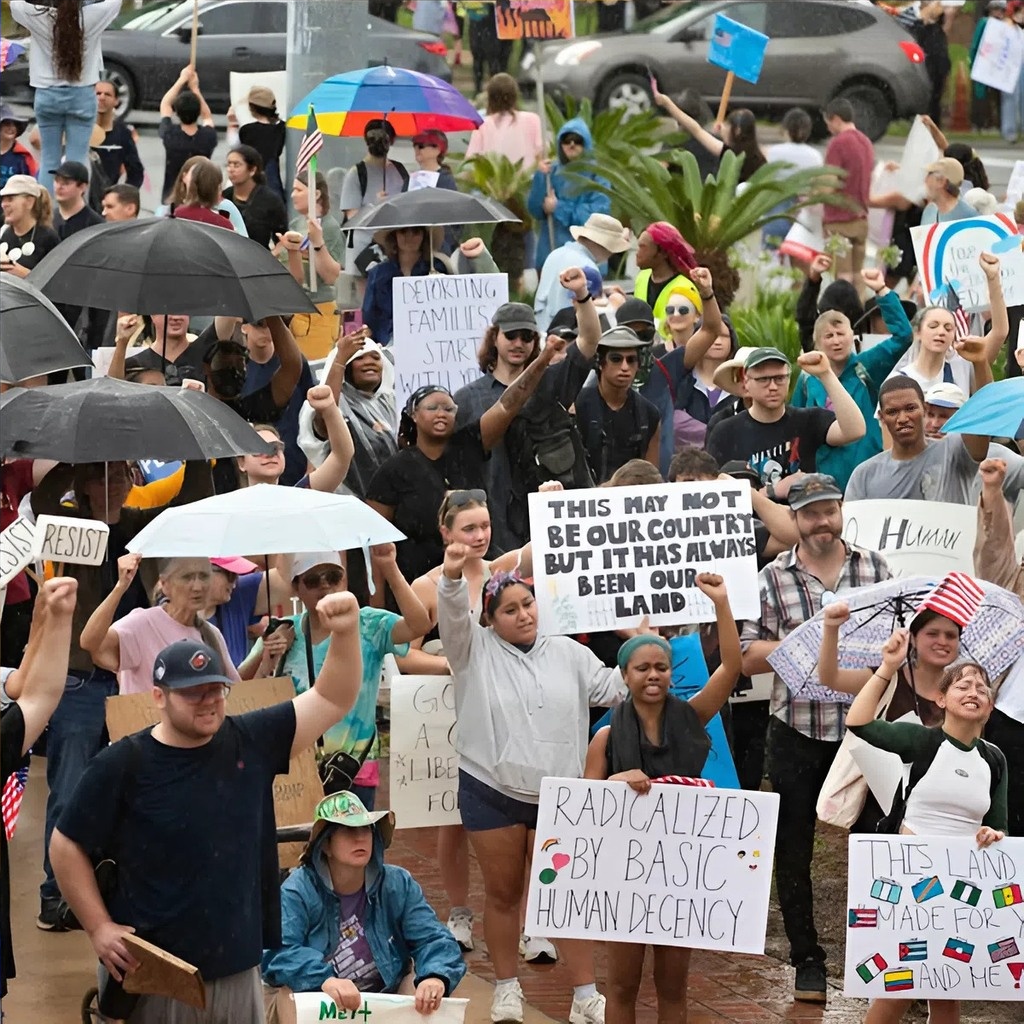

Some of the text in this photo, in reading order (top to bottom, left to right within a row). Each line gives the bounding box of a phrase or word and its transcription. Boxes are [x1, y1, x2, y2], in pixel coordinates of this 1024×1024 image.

[402, 278, 496, 305] DEPORTING
[408, 305, 489, 334] FAMILIES
[423, 337, 481, 365] START
[548, 490, 742, 519] THIS MAY NOT
[41, 523, 108, 560] RESIST
[547, 513, 754, 548] BE OUR COUNTRY
[544, 537, 756, 575] BUT IT HAS ALWAYS
[577, 568, 698, 597] BEEN OUR
[615, 592, 686, 618] LAND
[428, 789, 461, 813] FO
[554, 786, 760, 840] RADICALIZED
[570, 837, 728, 892] BY BASIC
[857, 839, 1017, 881] THIS LAND
[537, 888, 744, 946] HUMAN DECENCY
[877, 905, 945, 931] MADE
[953, 907, 1001, 933] FOR
[919, 962, 961, 992] AND
